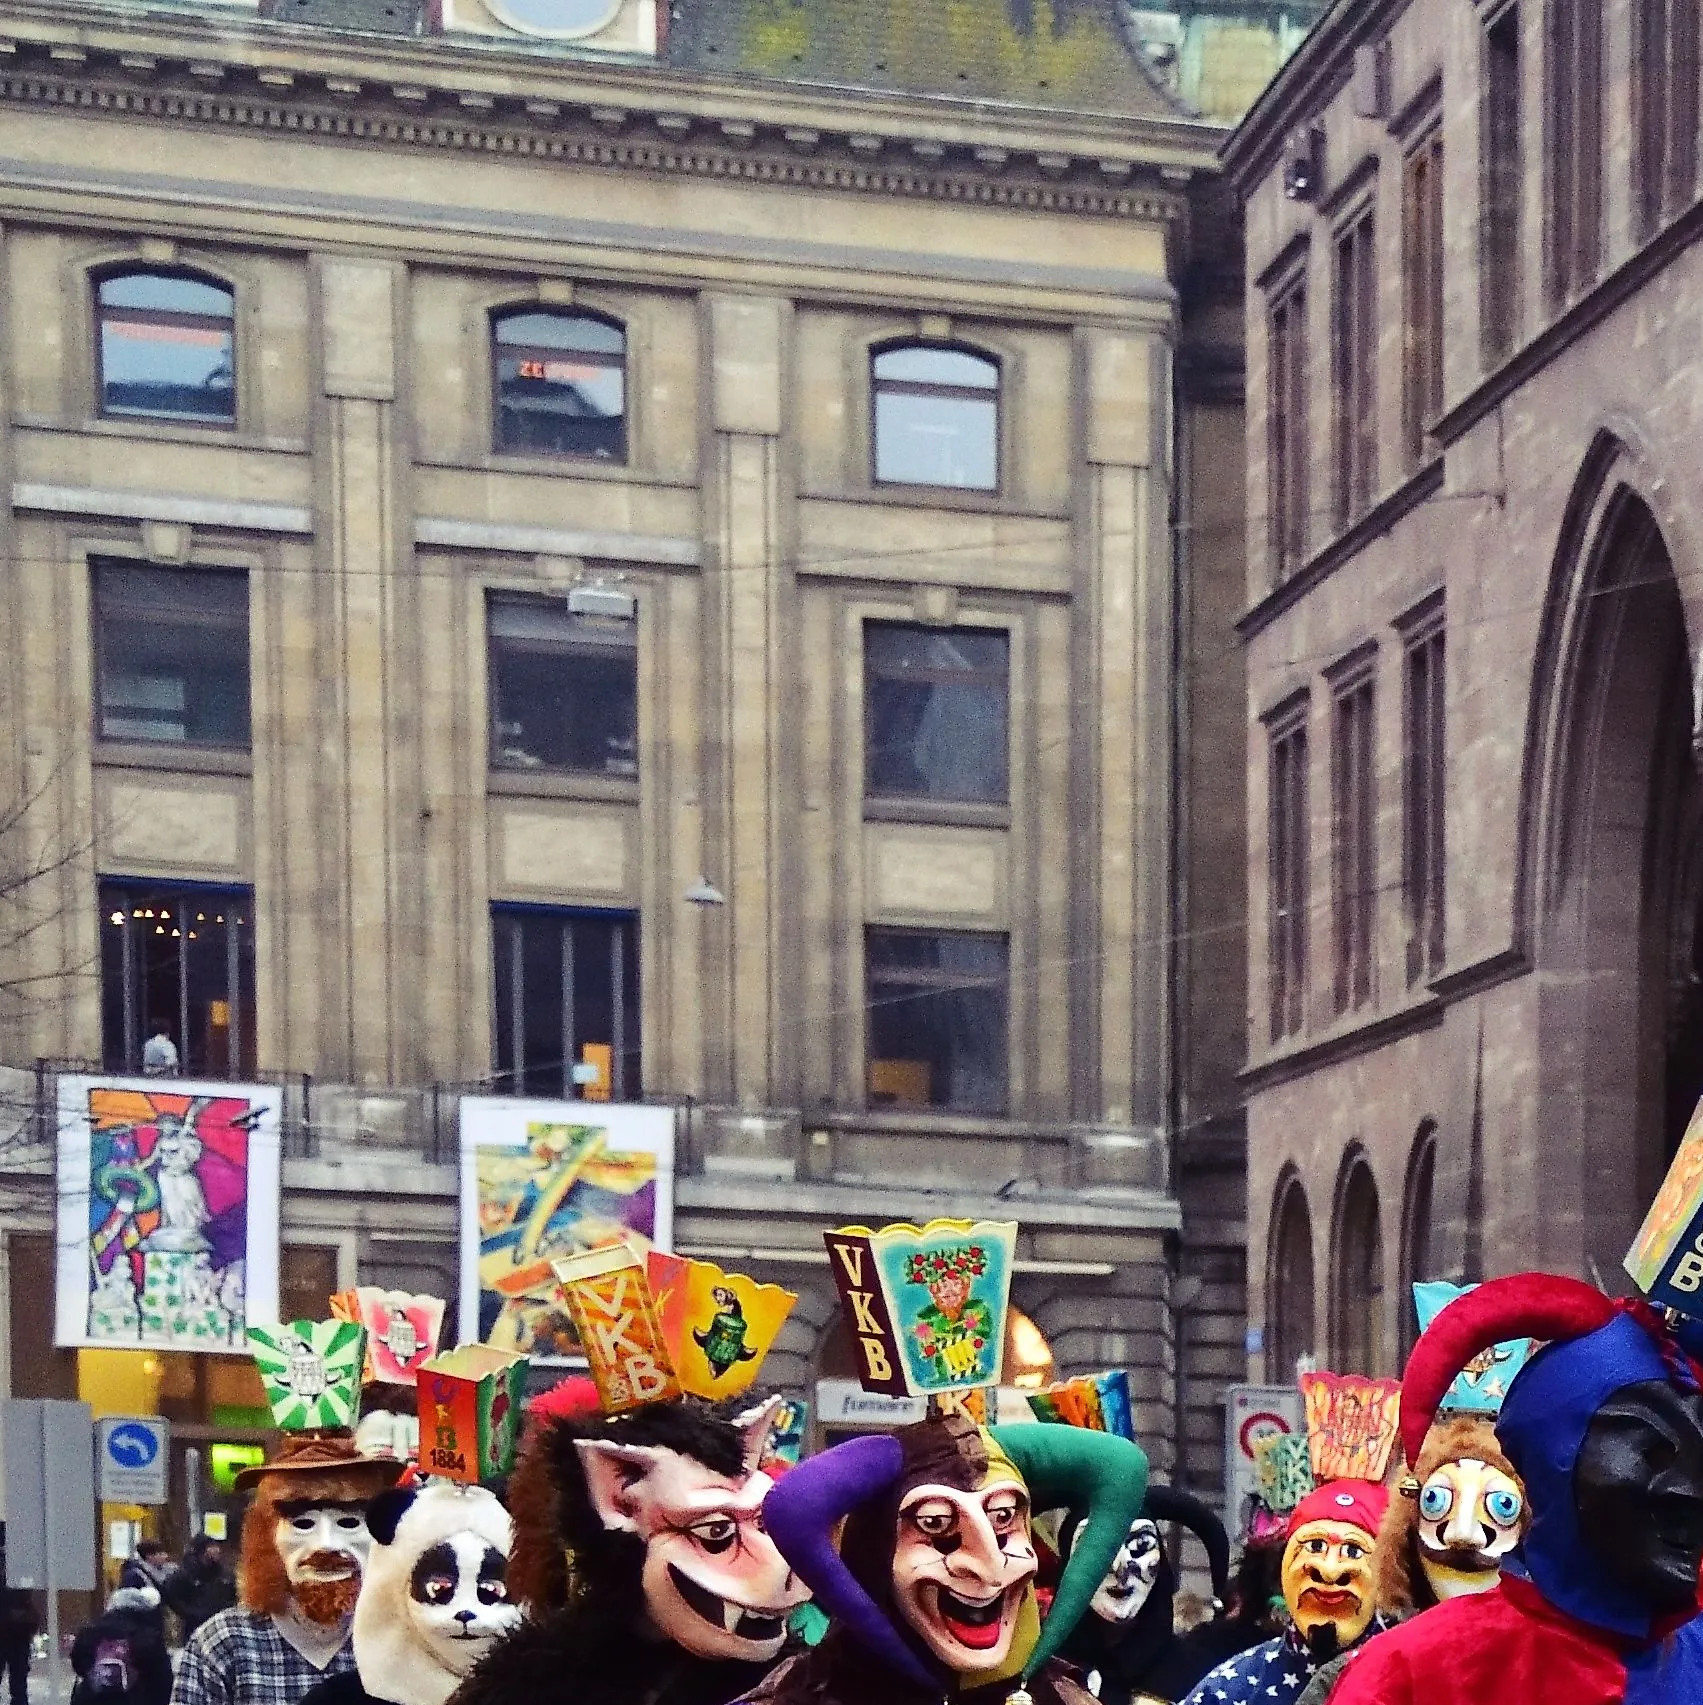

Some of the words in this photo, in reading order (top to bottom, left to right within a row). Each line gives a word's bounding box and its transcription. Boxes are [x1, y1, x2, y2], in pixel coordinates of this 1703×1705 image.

[577, 1273, 667, 1401] VKB
[833, 1244, 892, 1381] VKB
[430, 1448, 467, 1473] 1884
